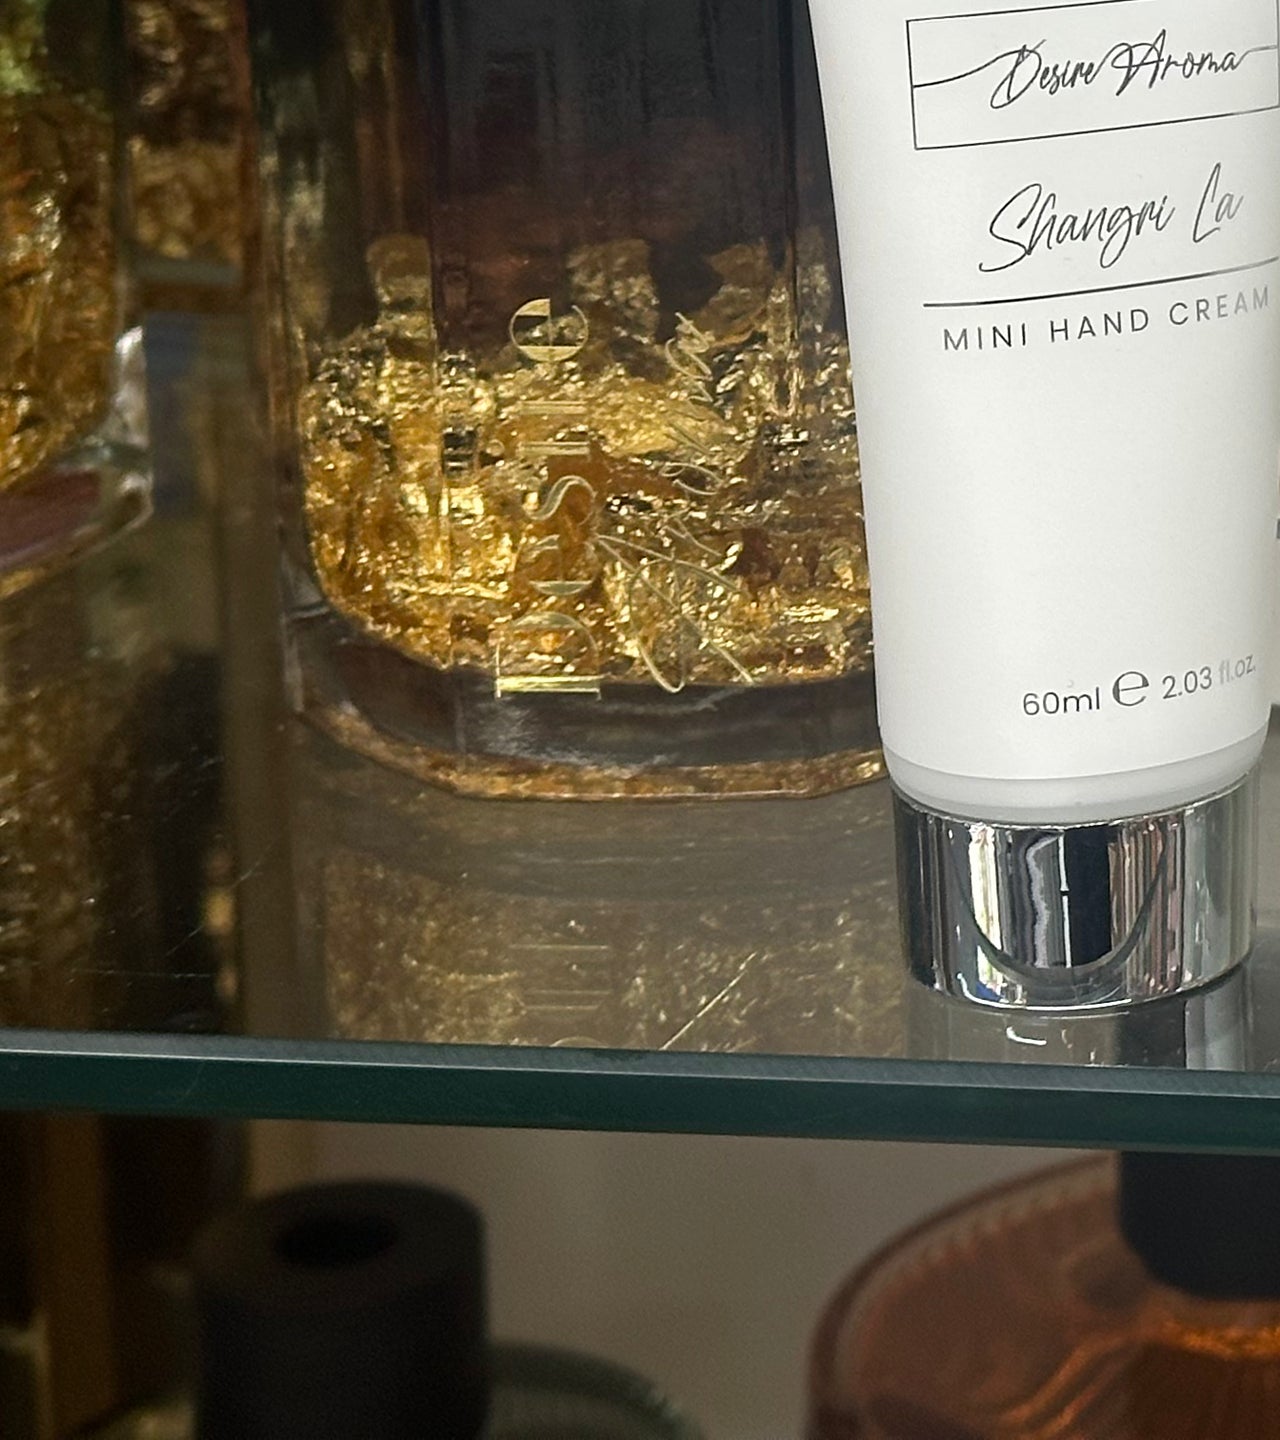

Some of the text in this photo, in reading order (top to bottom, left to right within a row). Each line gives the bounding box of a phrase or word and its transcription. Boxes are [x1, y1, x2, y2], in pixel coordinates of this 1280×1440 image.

[984, 29, 1245, 110] Desire Aroma
[977, 161, 1246, 273] Shangri La
[942, 285, 1271, 352] MINI HAND CREAM
[1022, 686, 1101, 716] 60ml
[1161, 665, 1213, 700] 2.03
